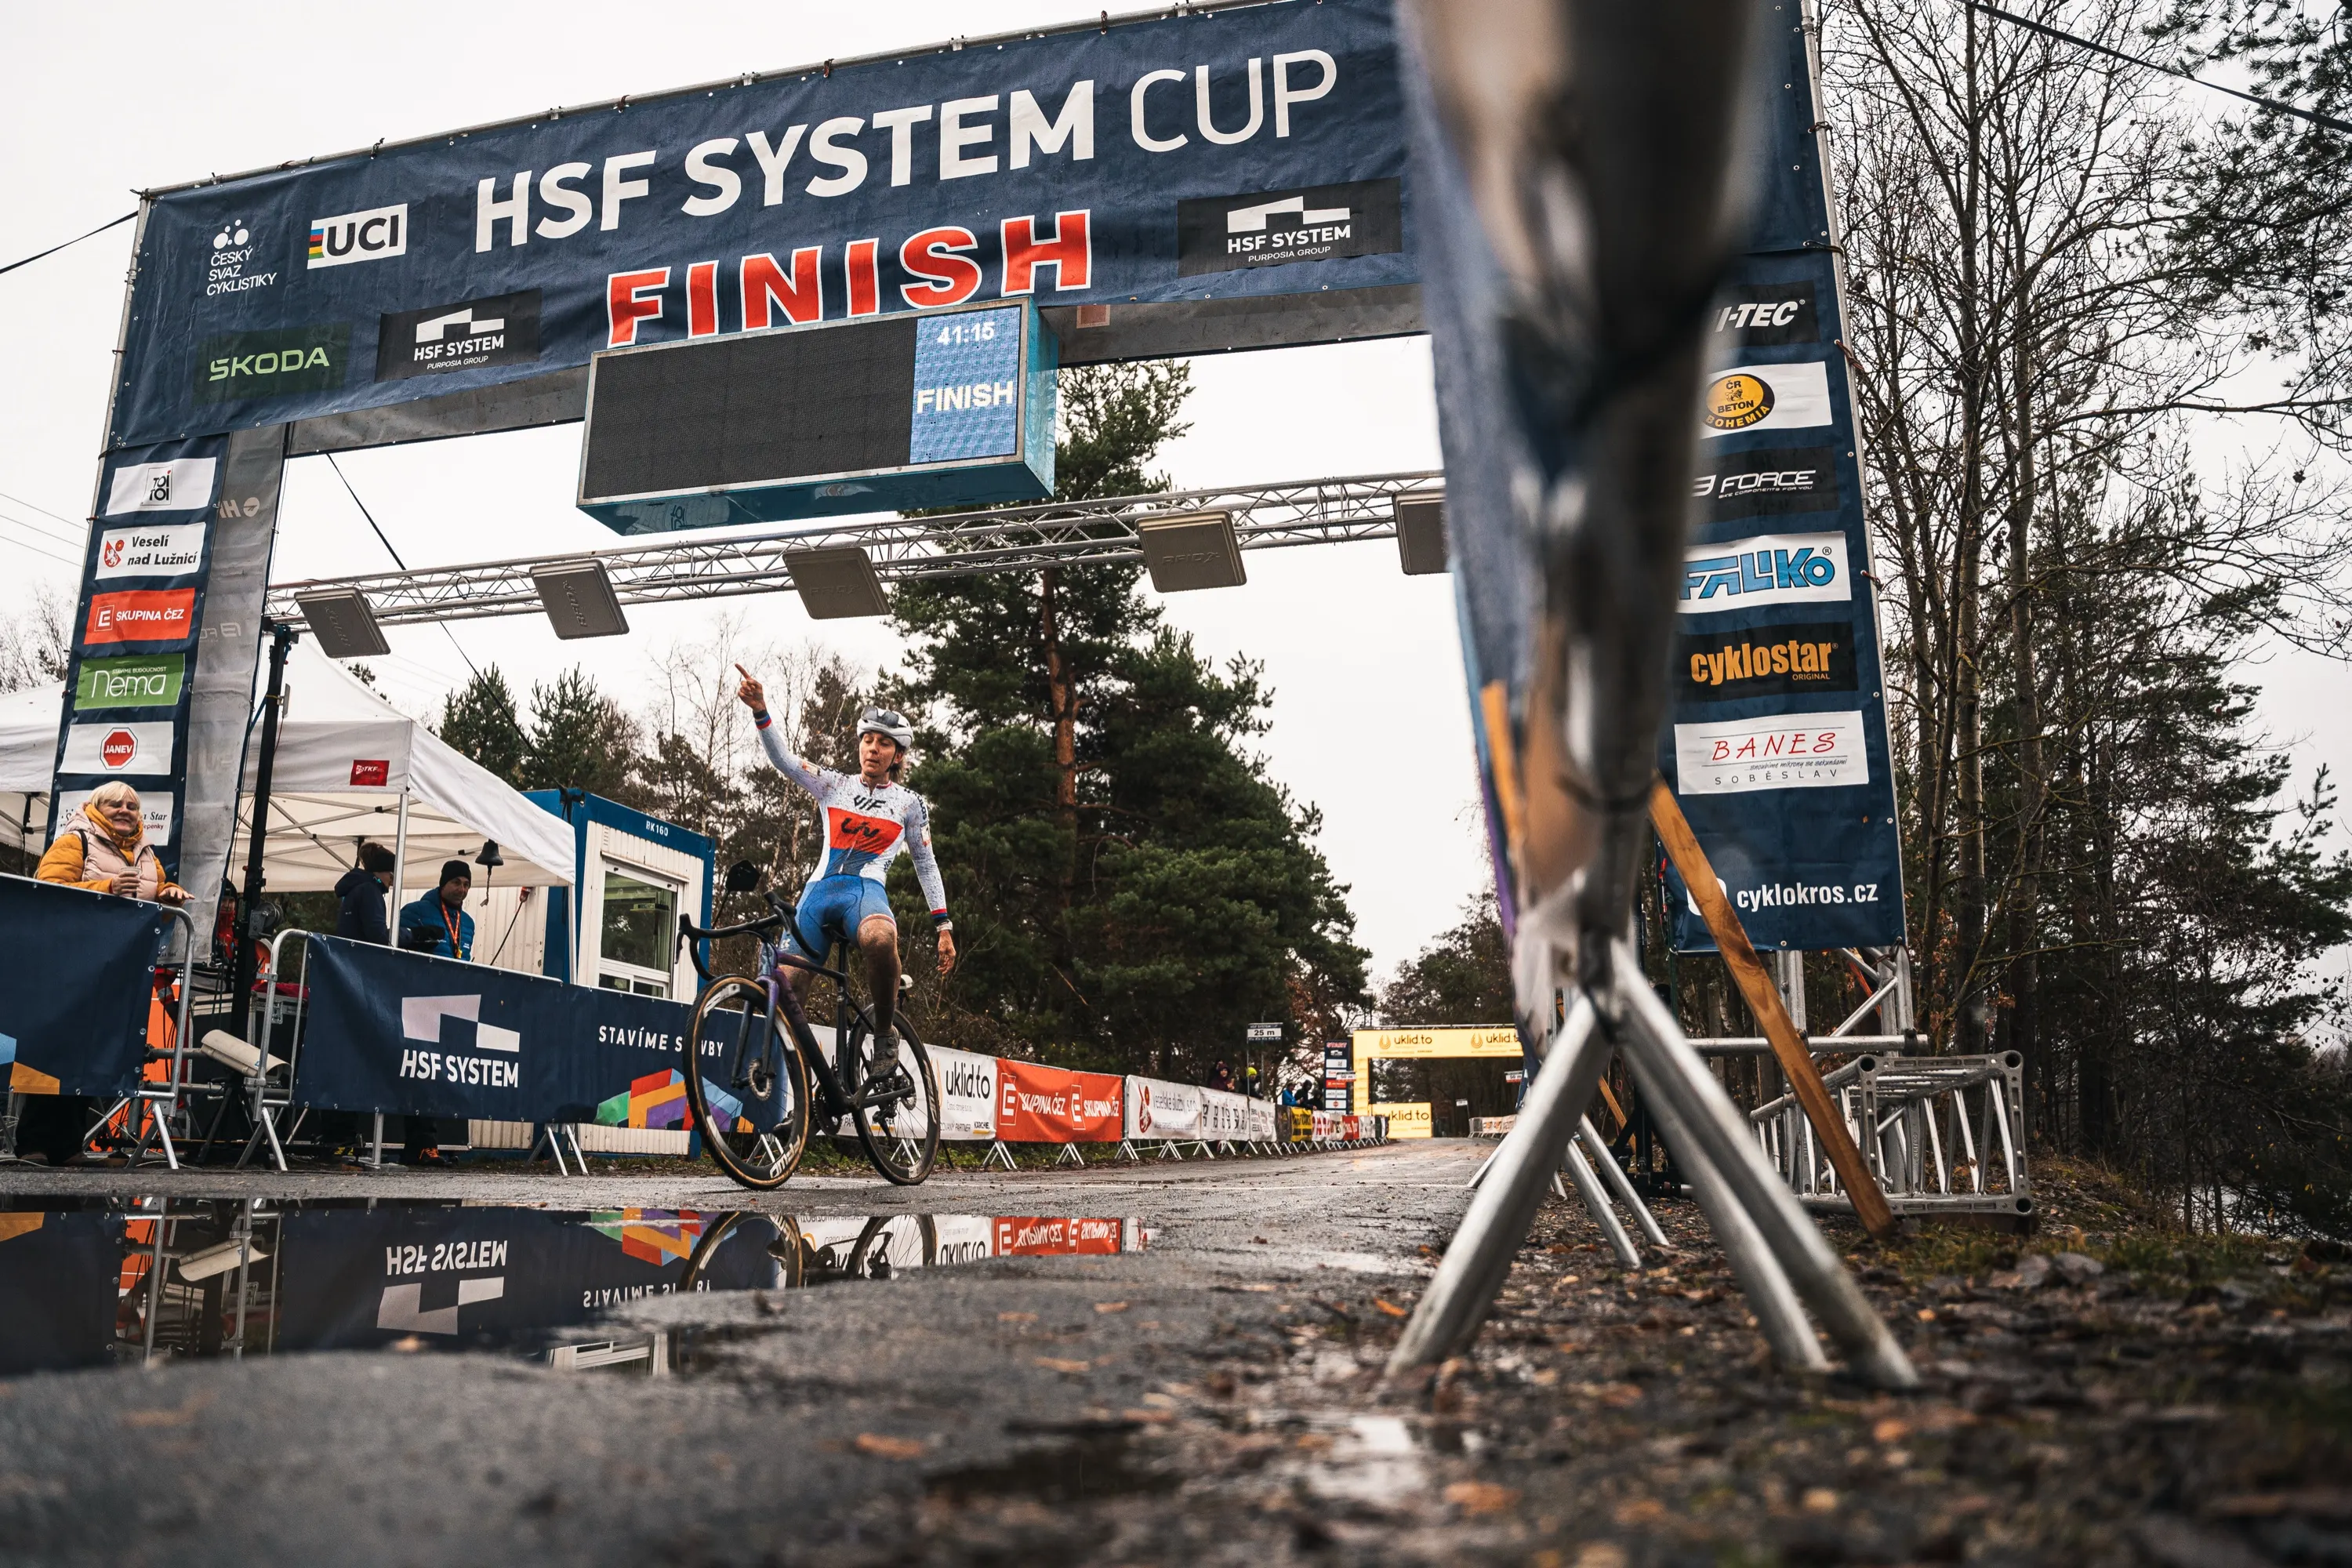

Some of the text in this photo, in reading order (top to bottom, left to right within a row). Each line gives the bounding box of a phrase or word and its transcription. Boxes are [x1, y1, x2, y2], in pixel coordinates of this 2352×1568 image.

[475, 49, 1337, 253] HSF SYSTEM CUP
[326, 215, 400, 256] UCI
[1228, 224, 1350, 253] HSF SYSTEM
[210, 245, 253, 267] ČESKÝ
[1248, 246, 1331, 262] PURPOSIA GROUP
[206, 273, 277, 296] CYKLISTIKY
[209, 265, 241, 281] SVAZ
[607, 209, 1091, 349] FINISH
[1715, 301, 1798, 332] I-TEC
[937, 321, 995, 345] 41:15
[414, 335, 504, 361] HSF SYSTEM
[426, 355, 488, 370] PURPOSIA GROUP
[1726, 379, 1741, 390] ČR
[916, 380, 1013, 414] FINISH
[1717, 400, 1755, 414] BETON
[1705, 405, 1770, 427] BOHEMIA
[1720, 470, 1817, 493] FORCE
[1735, 488, 1780, 496] COMPONENTS
[132, 535, 169, 547] Veselí
[128, 551, 198, 565] nad Lužnicí
[116, 610, 162, 622] SKUPINA
[164, 608, 184, 620] ČEZ
[1690, 640, 1832, 686] cyklostar
[105, 744, 133, 754] JANEV
[1712, 732, 1836, 760] BANES
[150, 811, 167, 821] Star
[1737, 882, 1878, 913] cyklokros.cz
[598, 1025, 724, 1057] STAVÍME SVBY
[1394, 1034, 1432, 1044] uklid.to
[1486, 1033, 1519, 1044] uklid.t
[399, 1049, 519, 1088] HSF SYSTEM
[946, 1061, 990, 1099] uklid.to
